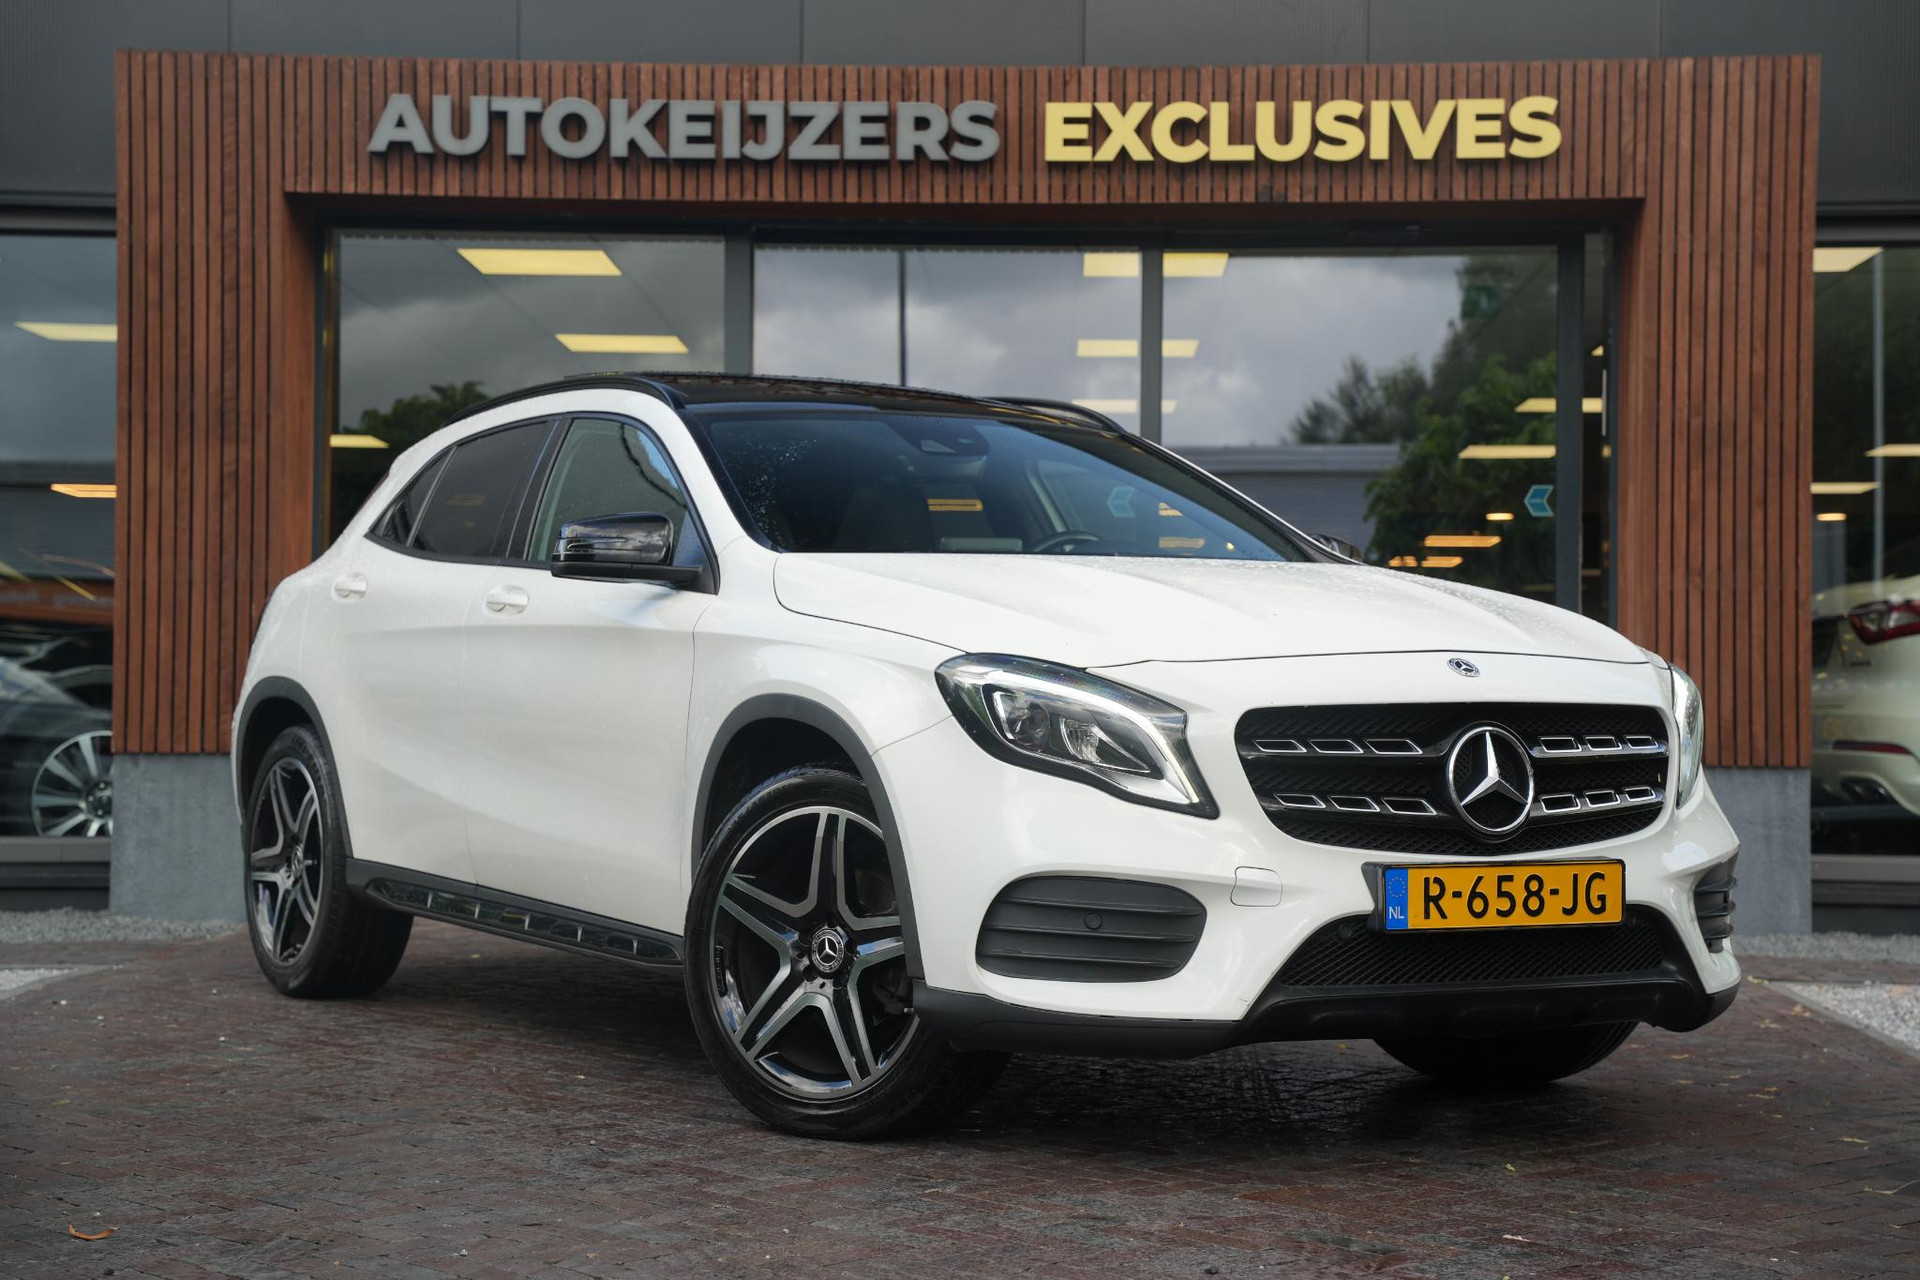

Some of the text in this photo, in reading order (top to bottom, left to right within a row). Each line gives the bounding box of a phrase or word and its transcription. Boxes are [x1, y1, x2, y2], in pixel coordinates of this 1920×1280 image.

[368, 93, 1562, 163] AUTOKEIJZERS EXCLUSIVES
[1388, 905, 1405, 920] NL
[1423, 872, 1607, 920] R-658-JG
